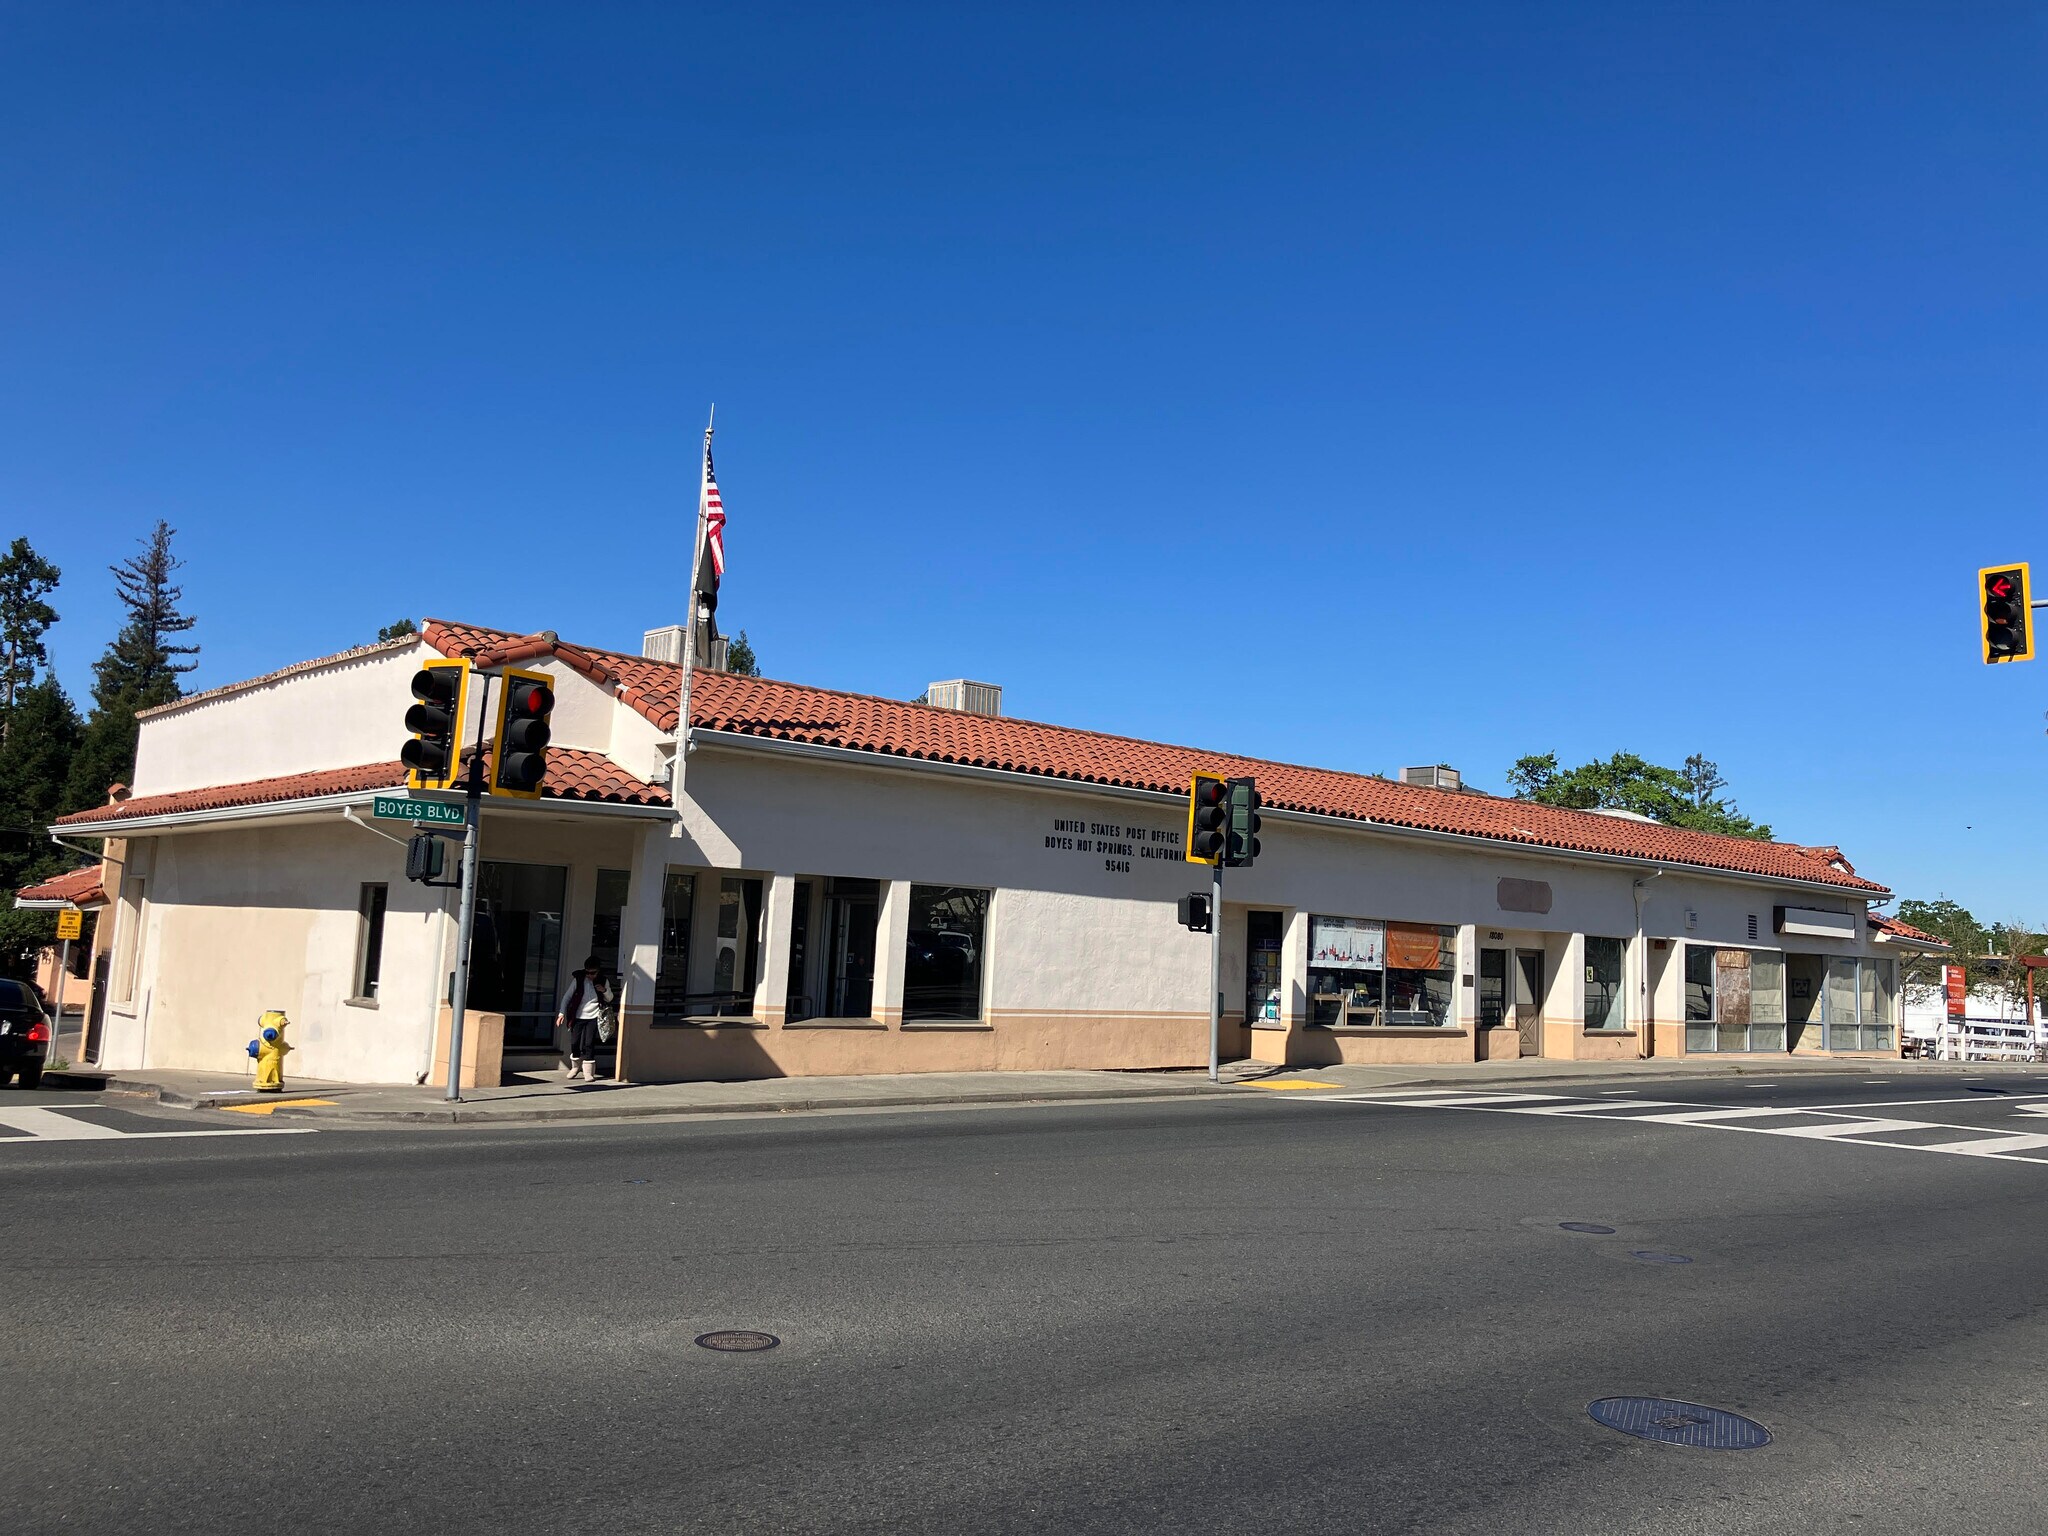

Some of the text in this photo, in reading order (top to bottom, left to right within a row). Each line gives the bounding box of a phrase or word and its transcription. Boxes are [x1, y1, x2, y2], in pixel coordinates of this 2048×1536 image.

[378, 801, 460, 820] BOYES BLVD
[1054, 819, 1179, 844] UNITED STATES POST OFFICE
[1045, 836, 1073, 850] BOYES
[1077, 839, 1092, 852] HOT
[1141, 846, 1187, 862] CALIFORNIA
[1105, 859, 1130, 873] 95416
